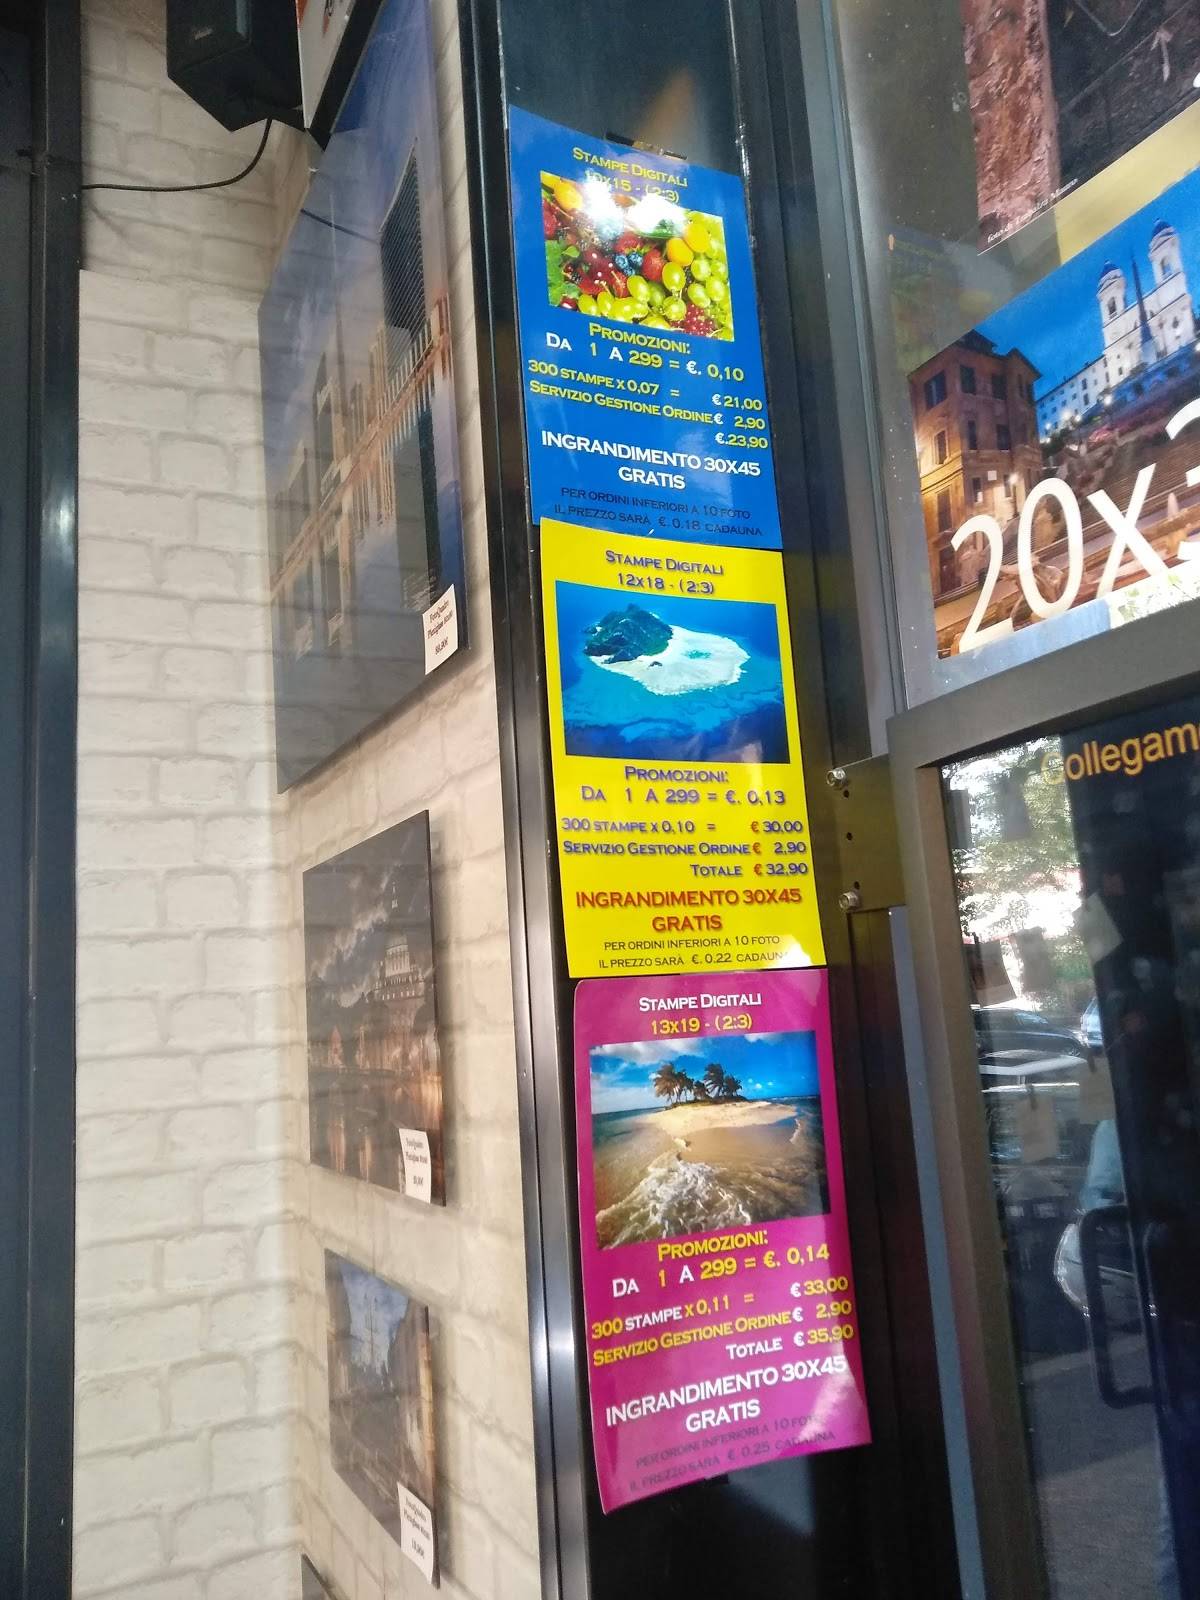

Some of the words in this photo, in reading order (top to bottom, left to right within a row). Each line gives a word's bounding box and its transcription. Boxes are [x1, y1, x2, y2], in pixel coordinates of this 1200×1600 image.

[573, 147, 629, 173] STAMPE
[631, 164, 688, 187] DIGITALI
[589, 322, 691, 354] PROMOZIONI:
[546, 332, 572, 351] DA
[590, 342, 597, 356] 1
[609, 346, 623, 361] A
[629, 350, 662, 368] 299
[707, 364, 744, 381] 0,10
[528, 359, 558, 376] 300
[560, 368, 614, 388] STAMPE
[724, 396, 762, 411] 21,00
[530, 380, 592, 403] SERVIZIO
[594, 393, 661, 415] GESTIONE
[663, 405, 713, 423] ORDINE
[735, 416, 765, 430] 2,90
[541, 430, 700, 470] INGRANDIMENTO
[703, 456, 761, 477] 30X45
[618, 466, 686, 489] GRATIS
[561, 487, 586, 498] PER
[588, 491, 630, 505] ORDINI
[632, 499, 688, 513] INFERIORI
[691, 505, 699, 514] A
[704, 505, 718, 517] 10
[720, 508, 751, 519] FOTO
[554, 504, 566, 515] IL
[568, 505, 616, 520] PREZZO
[705, 523, 763, 536] CADAUNA
[606, 550, 662, 568] STAMPE
[665, 558, 724, 575] DIGITALI
[1041, 722, 1200, 785] Collegam
[624, 765, 729, 783] PROMOZIONI:
[581, 785, 606, 802] DA
[625, 787, 632, 802] 1
[646, 788, 659, 803] A
[665, 788, 700, 804] 299
[747, 790, 785, 805] 0,13
[562, 817, 591, 831] 300
[594, 820, 647, 832] STAMPE
[563, 840, 625, 855] SERVIZIO
[628, 842, 696, 856] GESTIONE
[698, 842, 750, 855] ORDINE
[690, 863, 742, 877] TOTALE
[576, 889, 740, 909] INGRANDIMENTO
[742, 887, 803, 905] 30X45
[652, 914, 723, 933] GRATIS
[604, 941, 626, 951] PER
[628, 940, 665, 951] ORDINI
[667, 938, 721, 949] INFERIORI
[723, 937, 731, 946] A
[735, 935, 749, 946] 10
[751, 935, 780, 945] FOTO
[599, 959, 608, 969] IL
[610, 957, 653, 968] PREZZO
[639, 996, 698, 1013] STAMPE
[700, 993, 762, 1009] DIGITALI
[657, 1230, 768, 1262] PROMOZIONI:
[612, 1278, 640, 1298] DA
[659, 1269, 666, 1287] 1
[679, 1264, 694, 1284] A
[700, 1257, 737, 1280] 299
[786, 1243, 830, 1266] 0,14
[591, 1317, 623, 1340] 300
[625, 1306, 683, 1331] STAMPE
[593, 1337, 658, 1367] SERVIZIO
[660, 1321, 734, 1348] GESTIONE
[735, 1311, 792, 1332] ORDINE
[726, 1337, 783, 1361] TOTALE
[606, 1367, 779, 1427] INGRANDIMENTO
[781, 1354, 849, 1382] 30X45
[685, 1399, 760, 1433] GRATIS
[702, 1426, 760, 1448] INFERIORI
